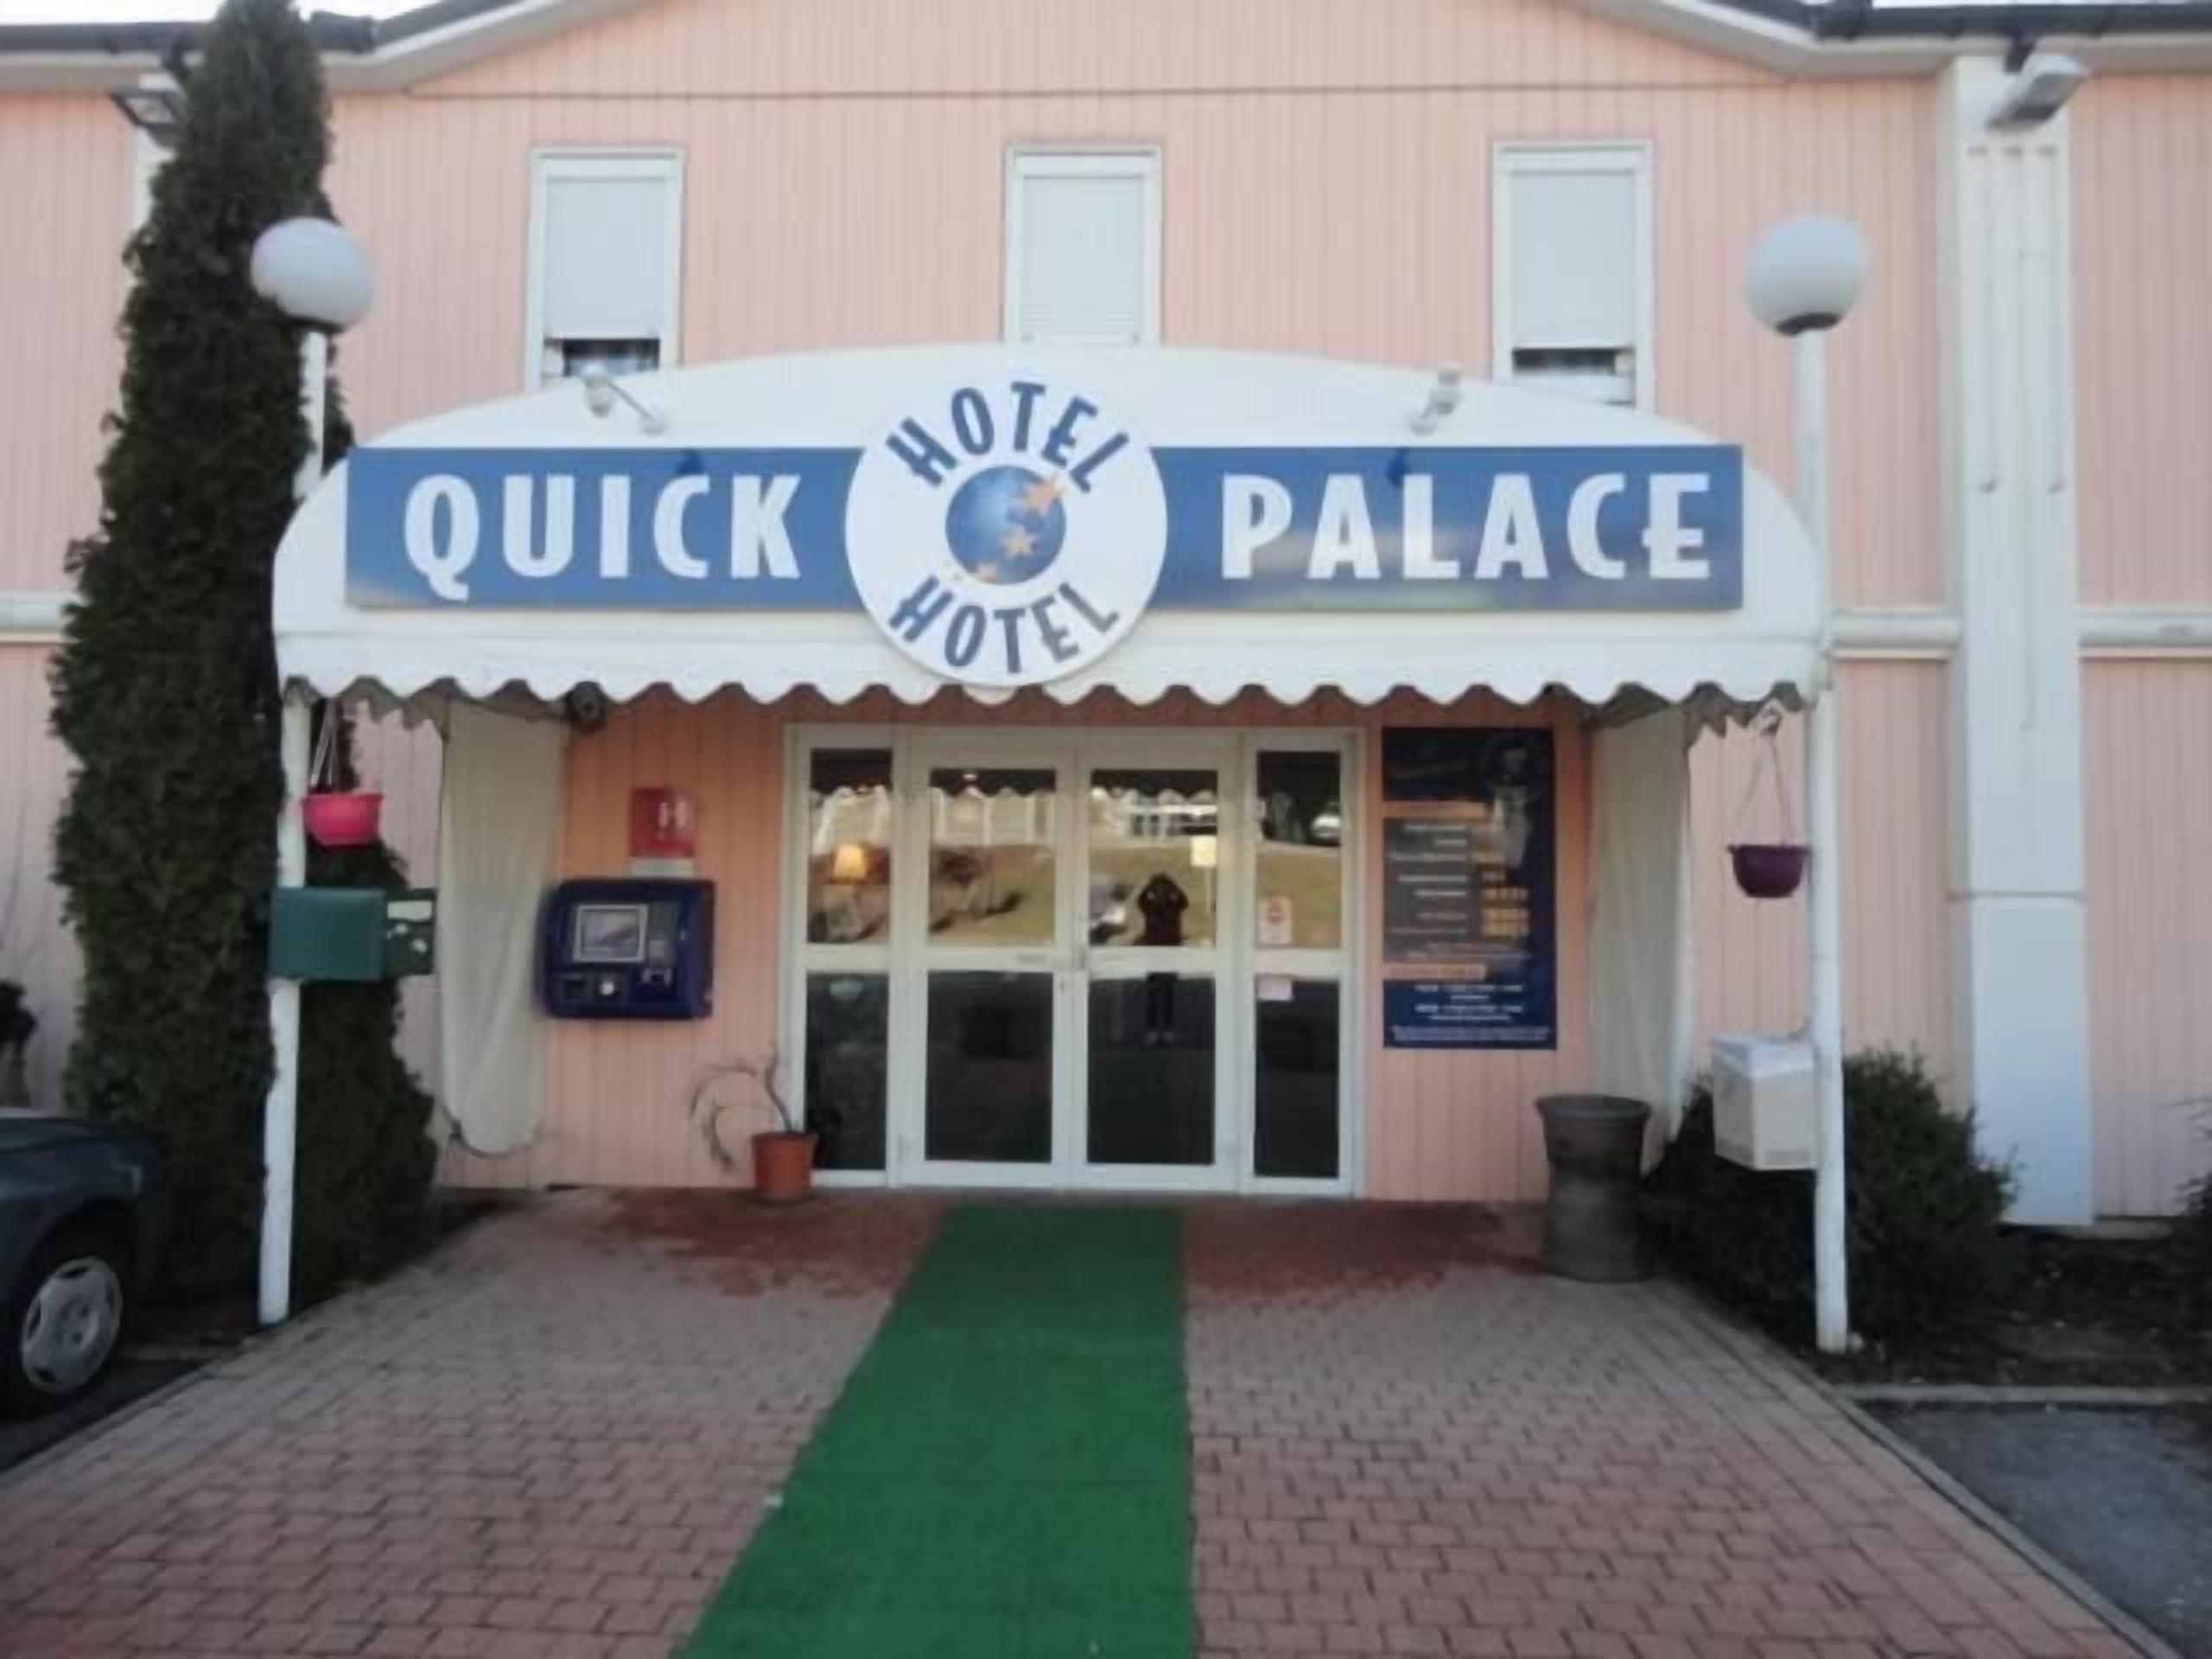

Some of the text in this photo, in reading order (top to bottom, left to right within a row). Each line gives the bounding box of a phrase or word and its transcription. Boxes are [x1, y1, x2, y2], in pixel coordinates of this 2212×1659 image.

[886, 380, 1131, 494] HOTEL
[403, 472, 1712, 601] QUICK PALACE
[889, 575, 1119, 674] HOTEL
